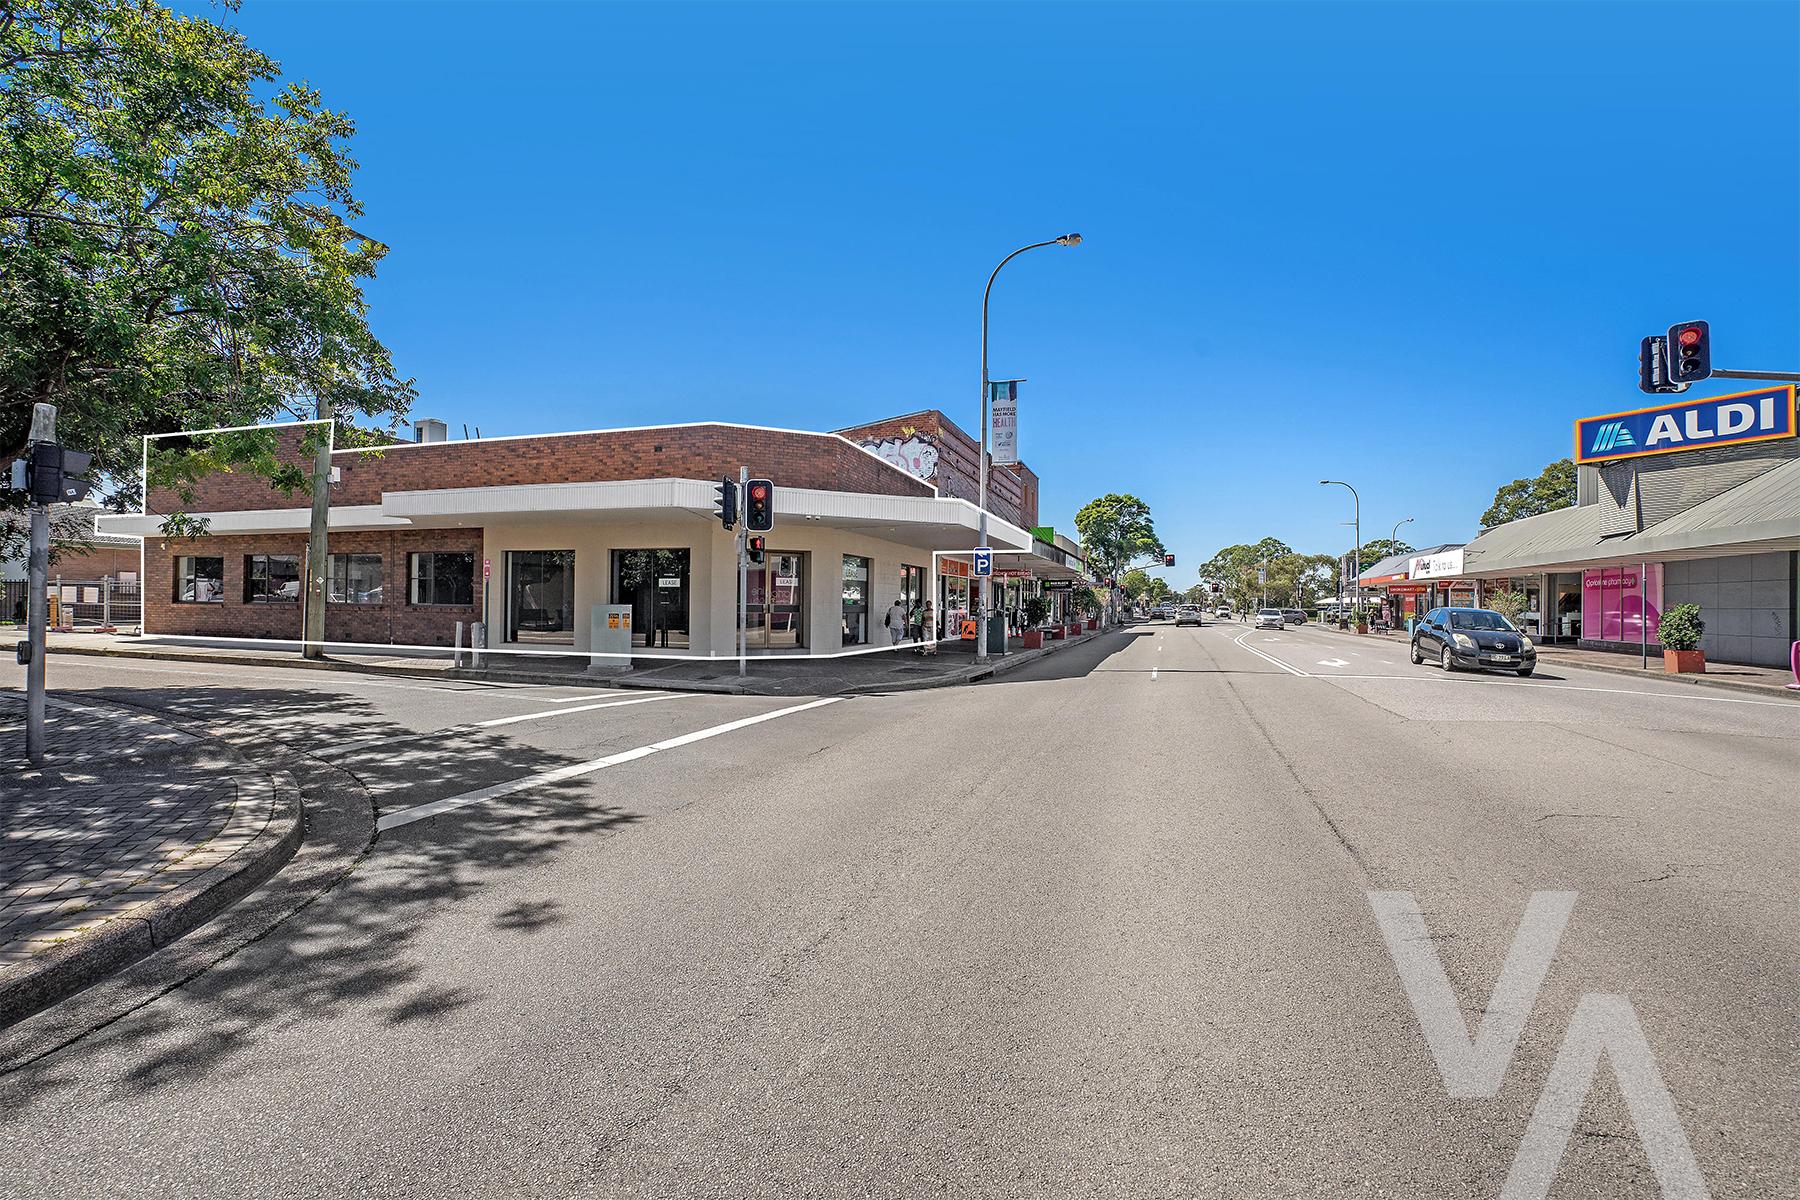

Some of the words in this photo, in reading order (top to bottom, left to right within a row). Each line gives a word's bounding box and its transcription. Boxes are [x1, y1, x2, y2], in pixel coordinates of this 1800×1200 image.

[992, 417, 1016, 428] HEALTH
[1645, 397, 1774, 446] ALDI
[977, 559, 989, 573] P
